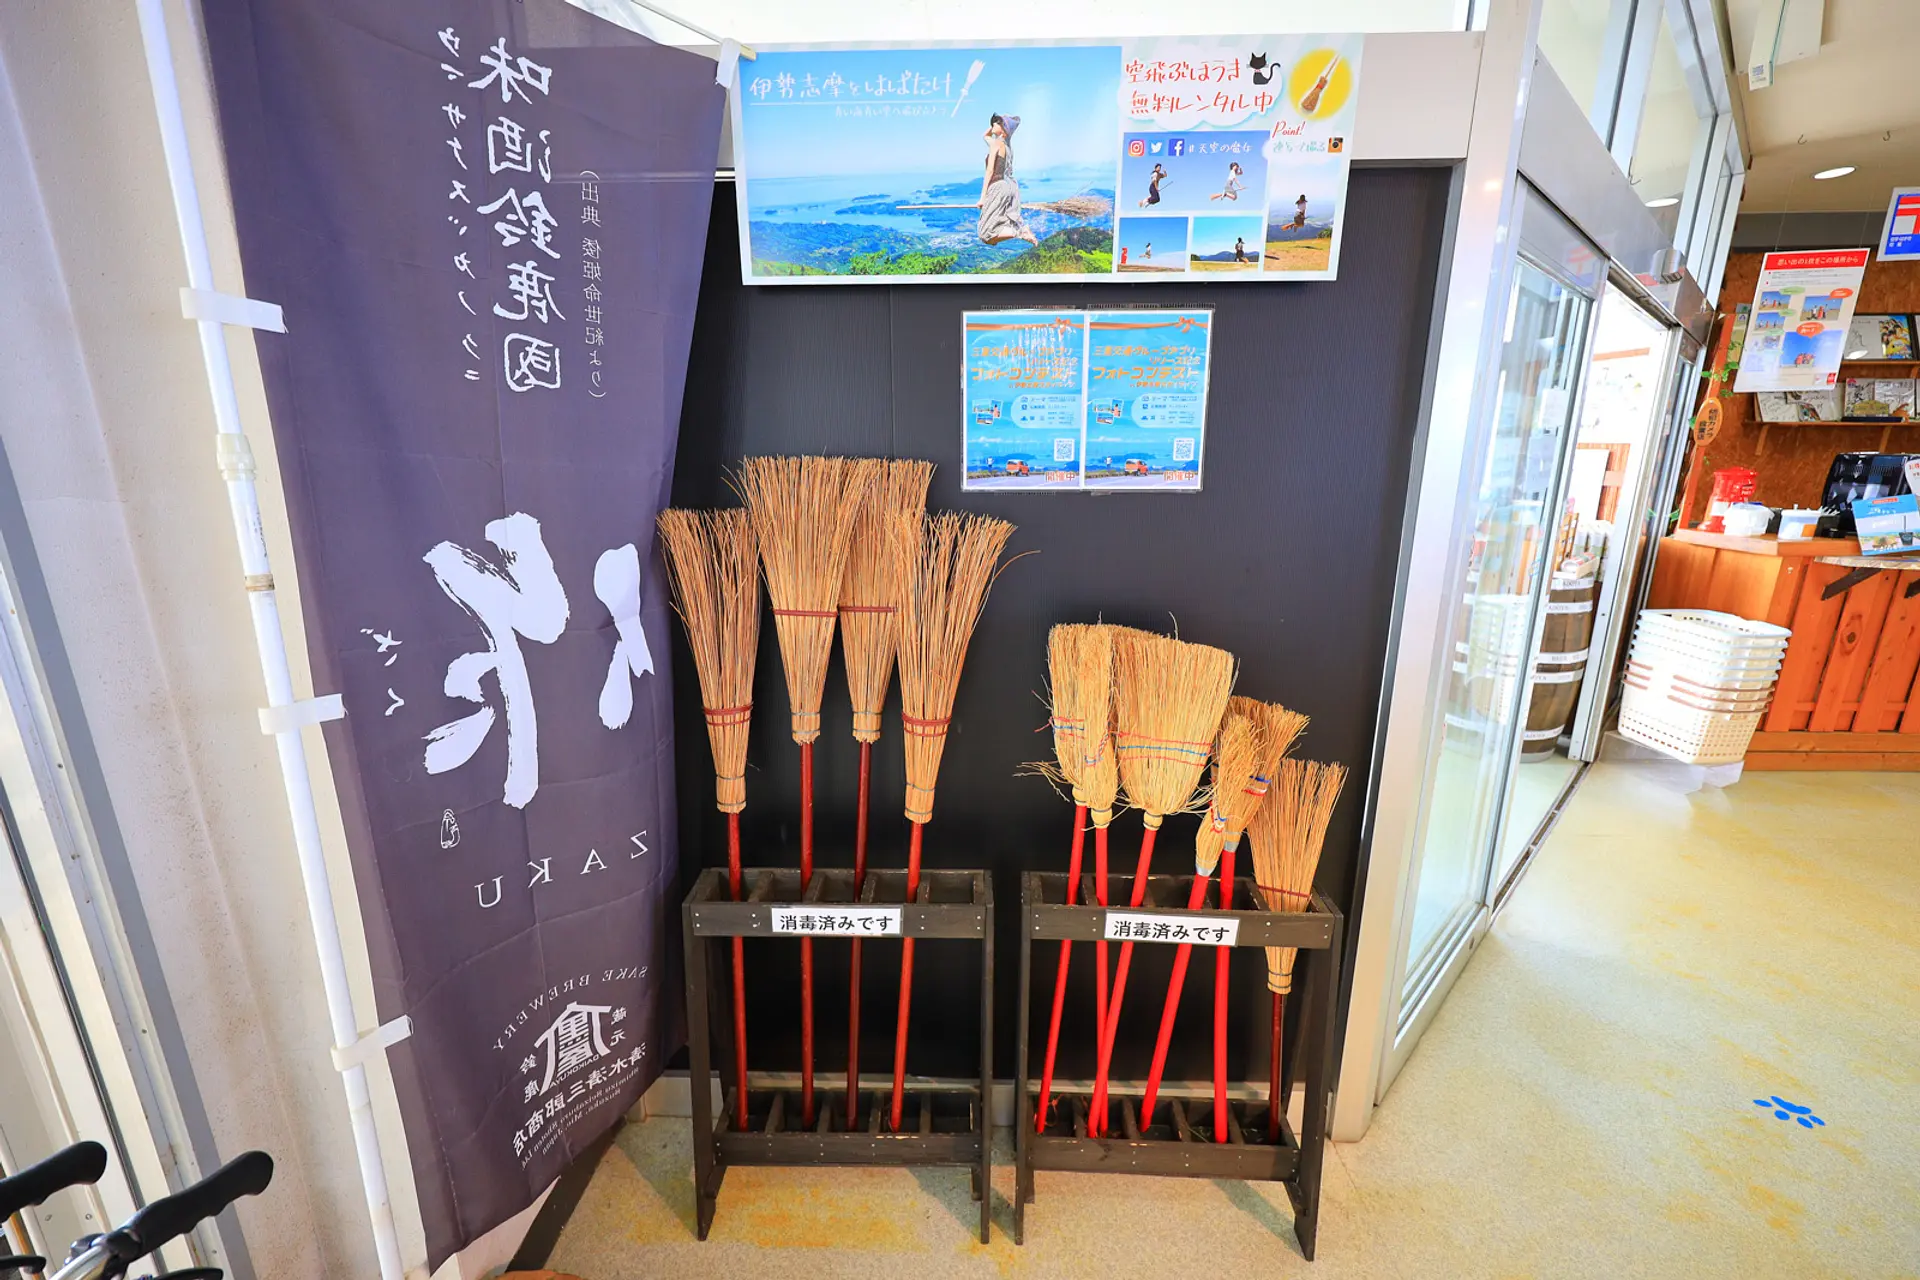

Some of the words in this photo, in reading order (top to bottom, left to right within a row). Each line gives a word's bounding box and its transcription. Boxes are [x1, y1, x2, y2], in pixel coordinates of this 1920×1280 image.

[1125, 58, 1241, 84] 空飛ぶほうき
[1130, 91, 1274, 115] 無料レンタル中
[1272, 120, 1306, 139] Point!
[970, 367, 1077, 381] フォトコンテスト
[1092, 366, 1201, 381] フォトコンテスト
[1044, 471, 1076, 482] 開催中
[1163, 470, 1195, 481] 開催中
[780, 914, 895, 934] 消毒済みです
[1112, 918, 1232, 943] 消毒済みです
